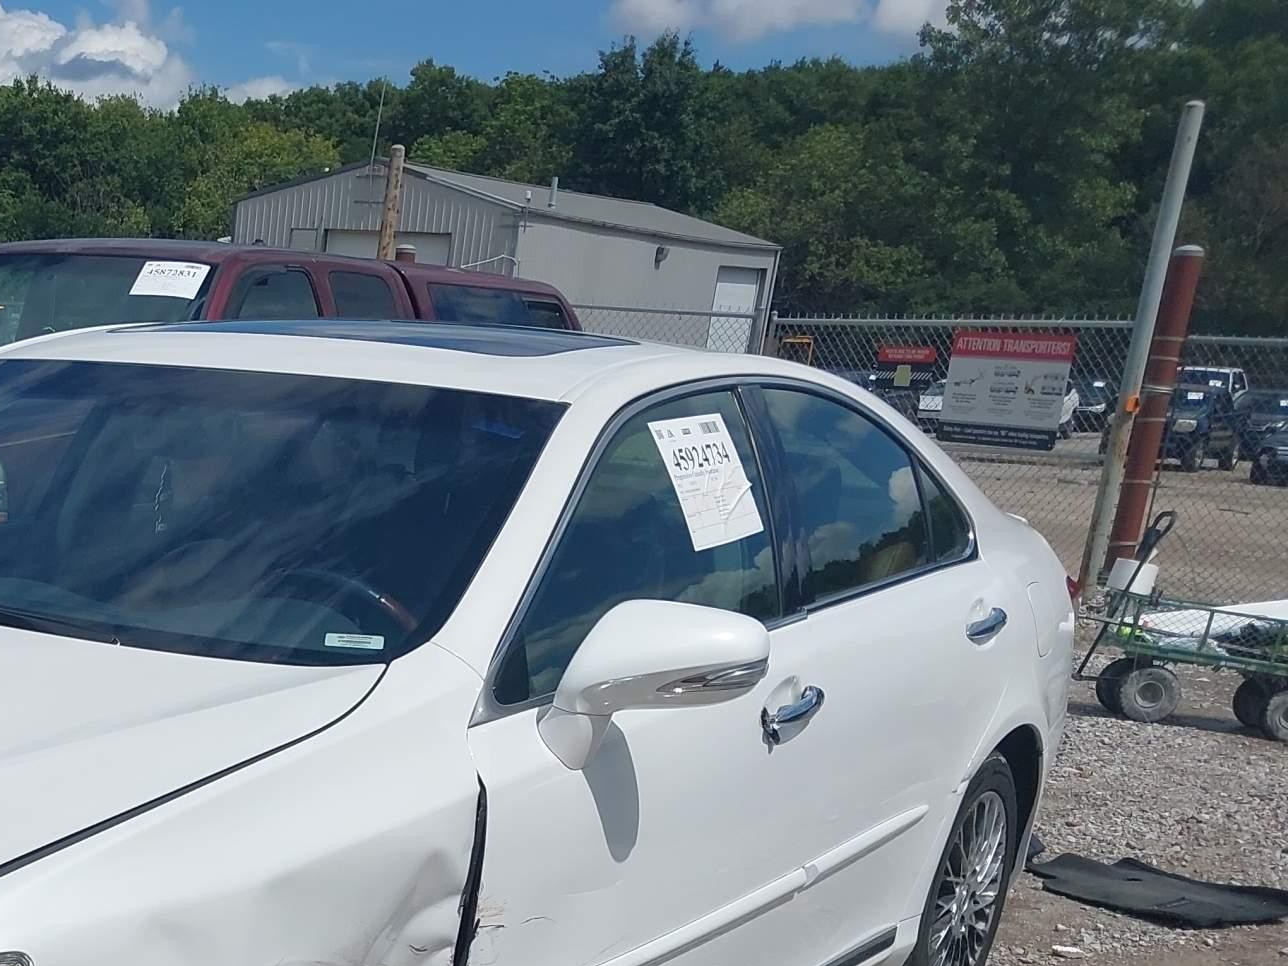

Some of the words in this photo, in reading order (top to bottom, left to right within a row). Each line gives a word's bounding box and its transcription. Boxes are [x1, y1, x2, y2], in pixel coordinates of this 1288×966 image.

[147, 268, 197, 278] 45872831
[956, 337, 1001, 351] ATTENTION
[672, 441, 731, 471] 45924734
